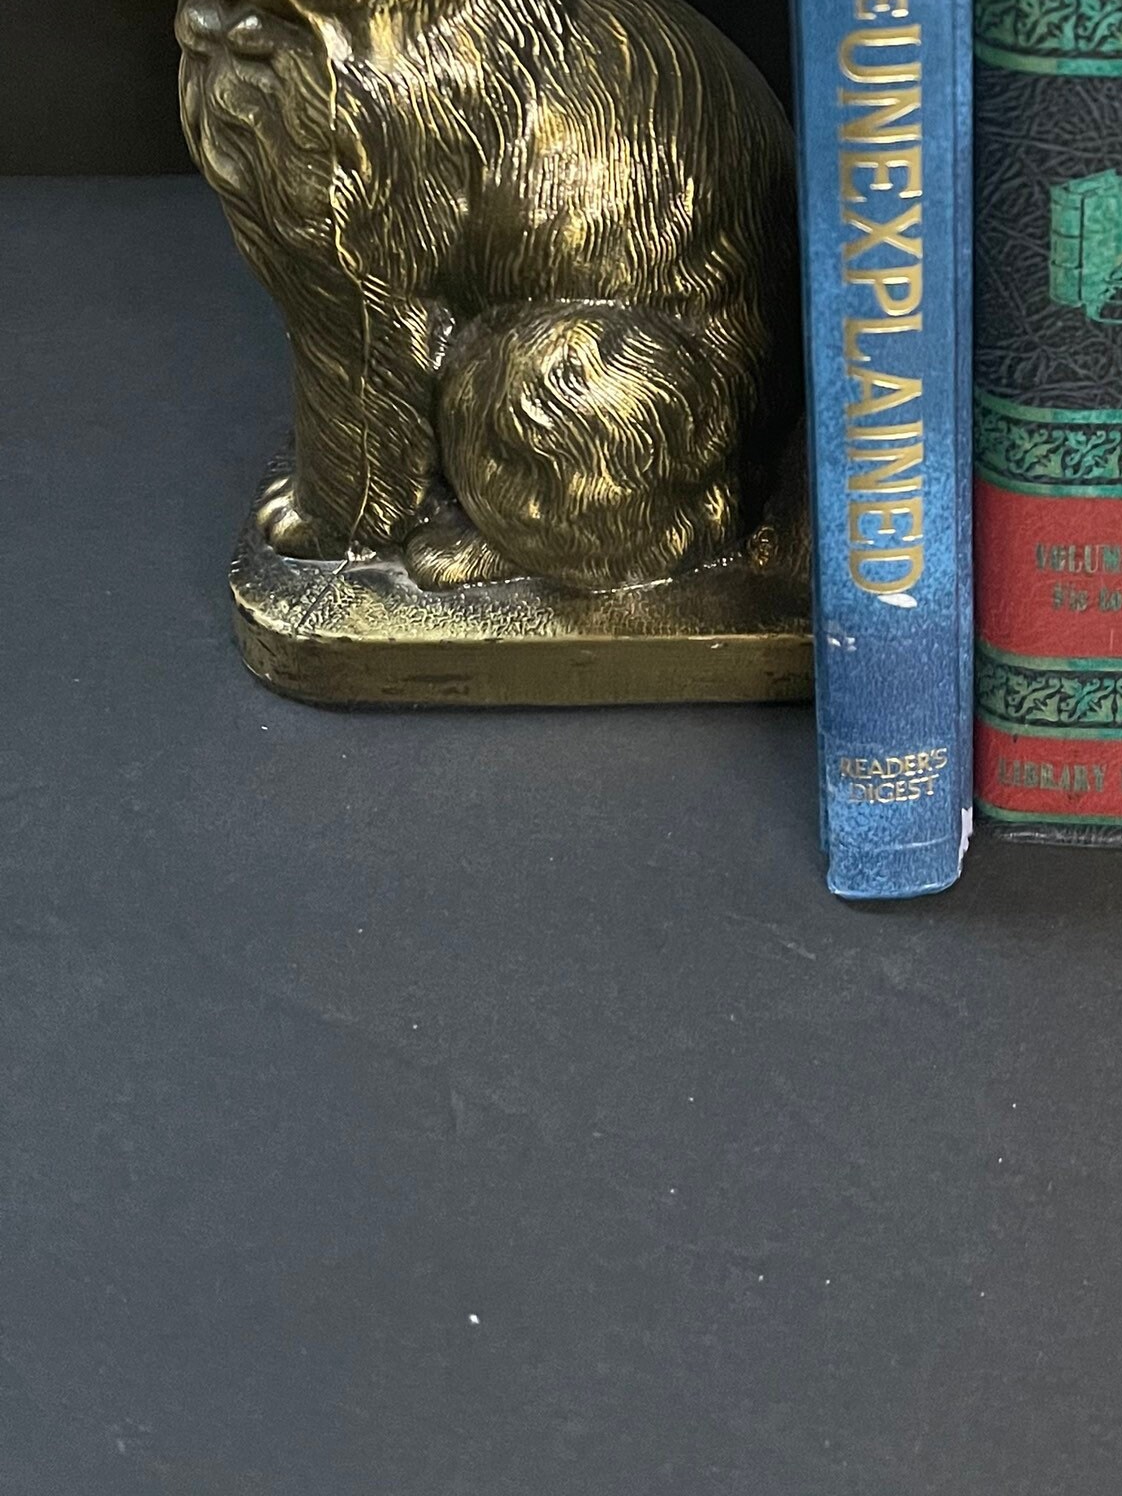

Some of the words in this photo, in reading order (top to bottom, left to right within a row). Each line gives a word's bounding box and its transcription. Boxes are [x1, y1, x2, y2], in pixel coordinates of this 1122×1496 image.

[836, 24, 923, 598] UNEXPLAINED
[839, 748, 949, 779] READER'S
[998, 756, 1107, 792] LIBRARY
[850, 774, 940, 804] DIGEST
